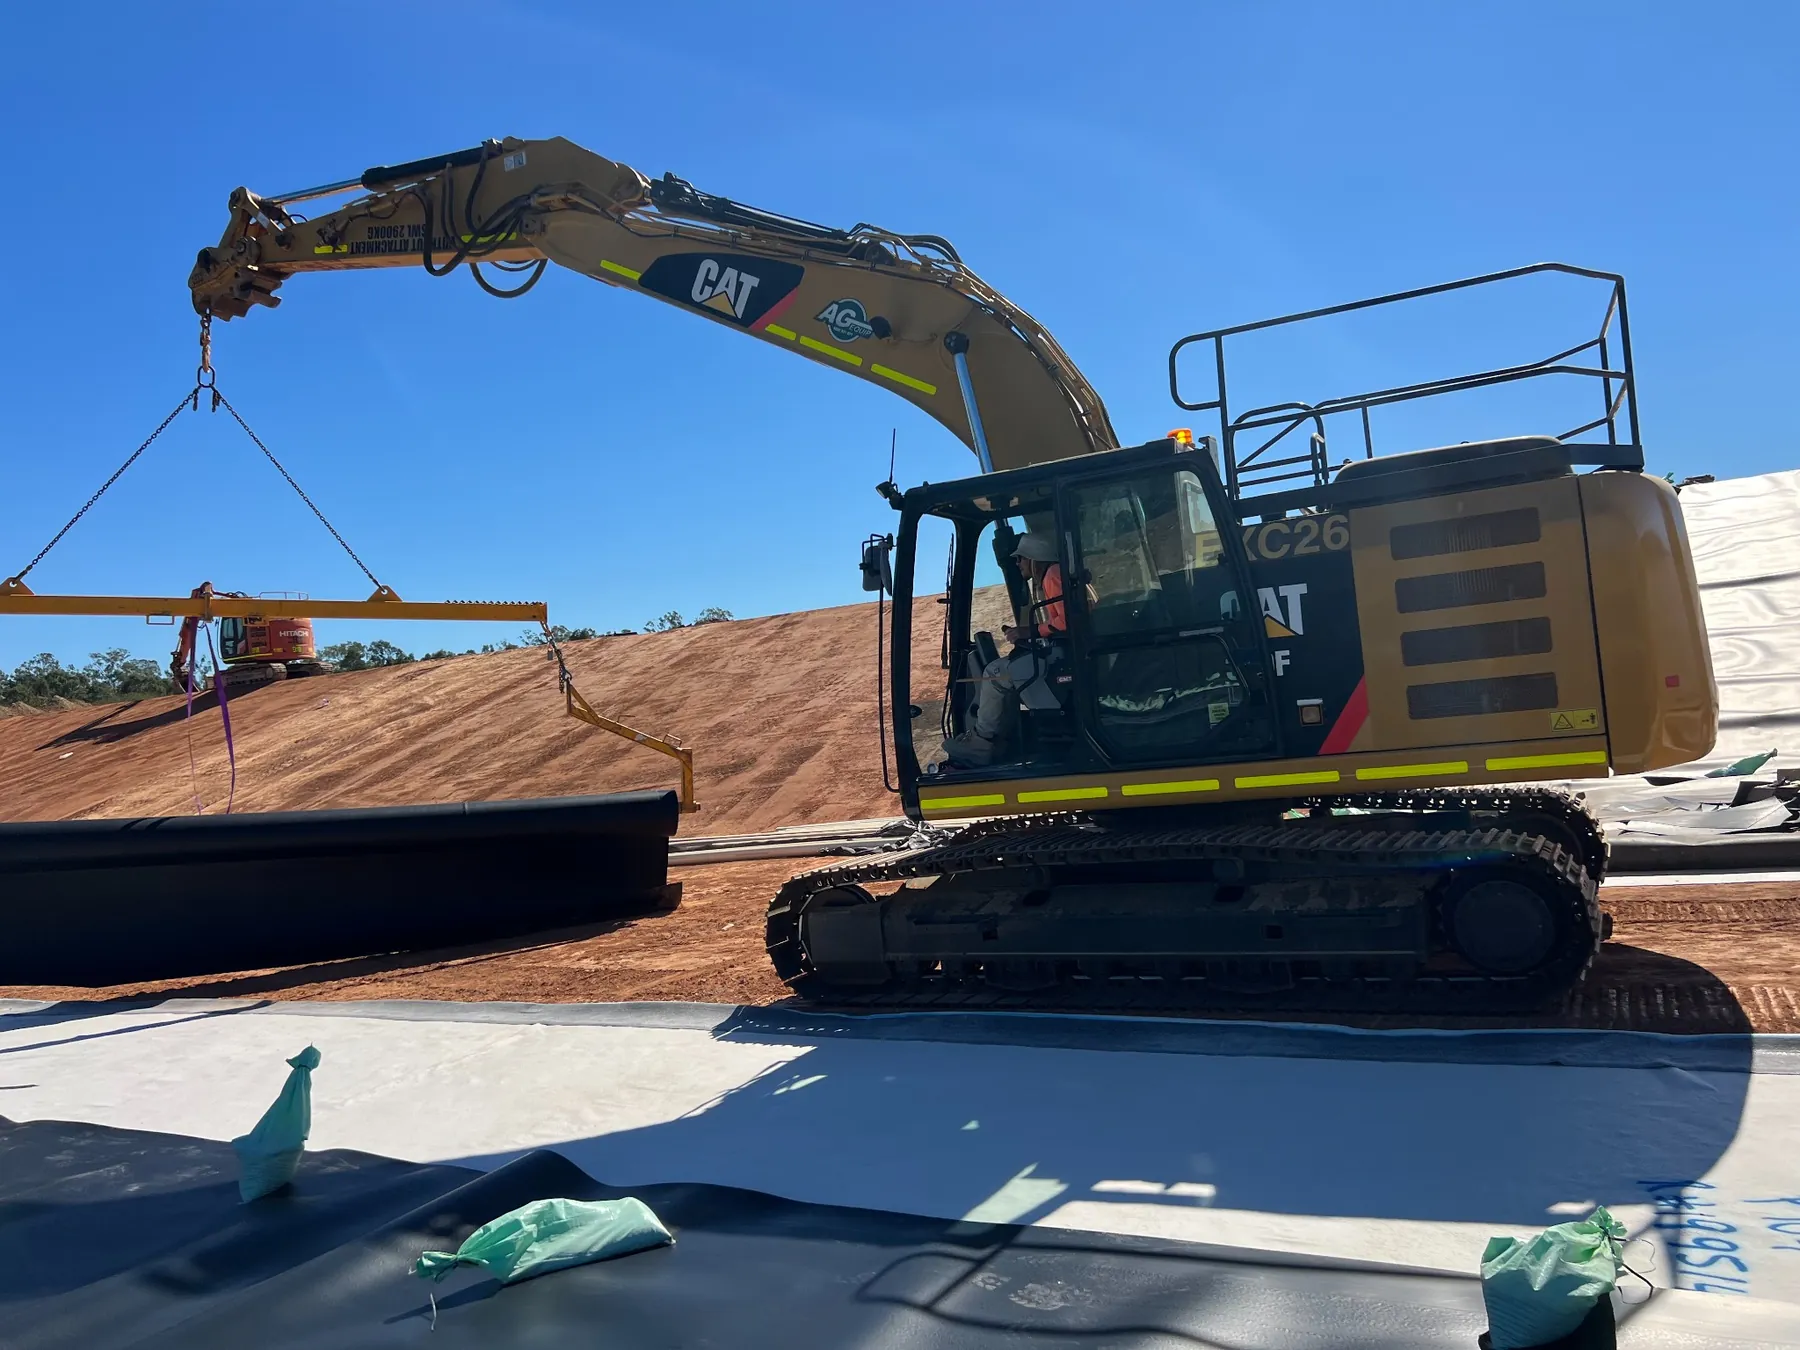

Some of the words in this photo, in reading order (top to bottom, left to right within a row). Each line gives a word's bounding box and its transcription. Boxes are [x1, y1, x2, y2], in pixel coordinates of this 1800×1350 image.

[367, 225, 405, 239] 2900KG
[408, 224, 426, 238] SWL
[349, 239, 409, 255] ATTACHMENT
[411, 236, 456, 252] WITHUT
[691, 258, 760, 319] CAT
[818, 302, 862, 328] AG
[849, 322, 873, 337] EQUIP
